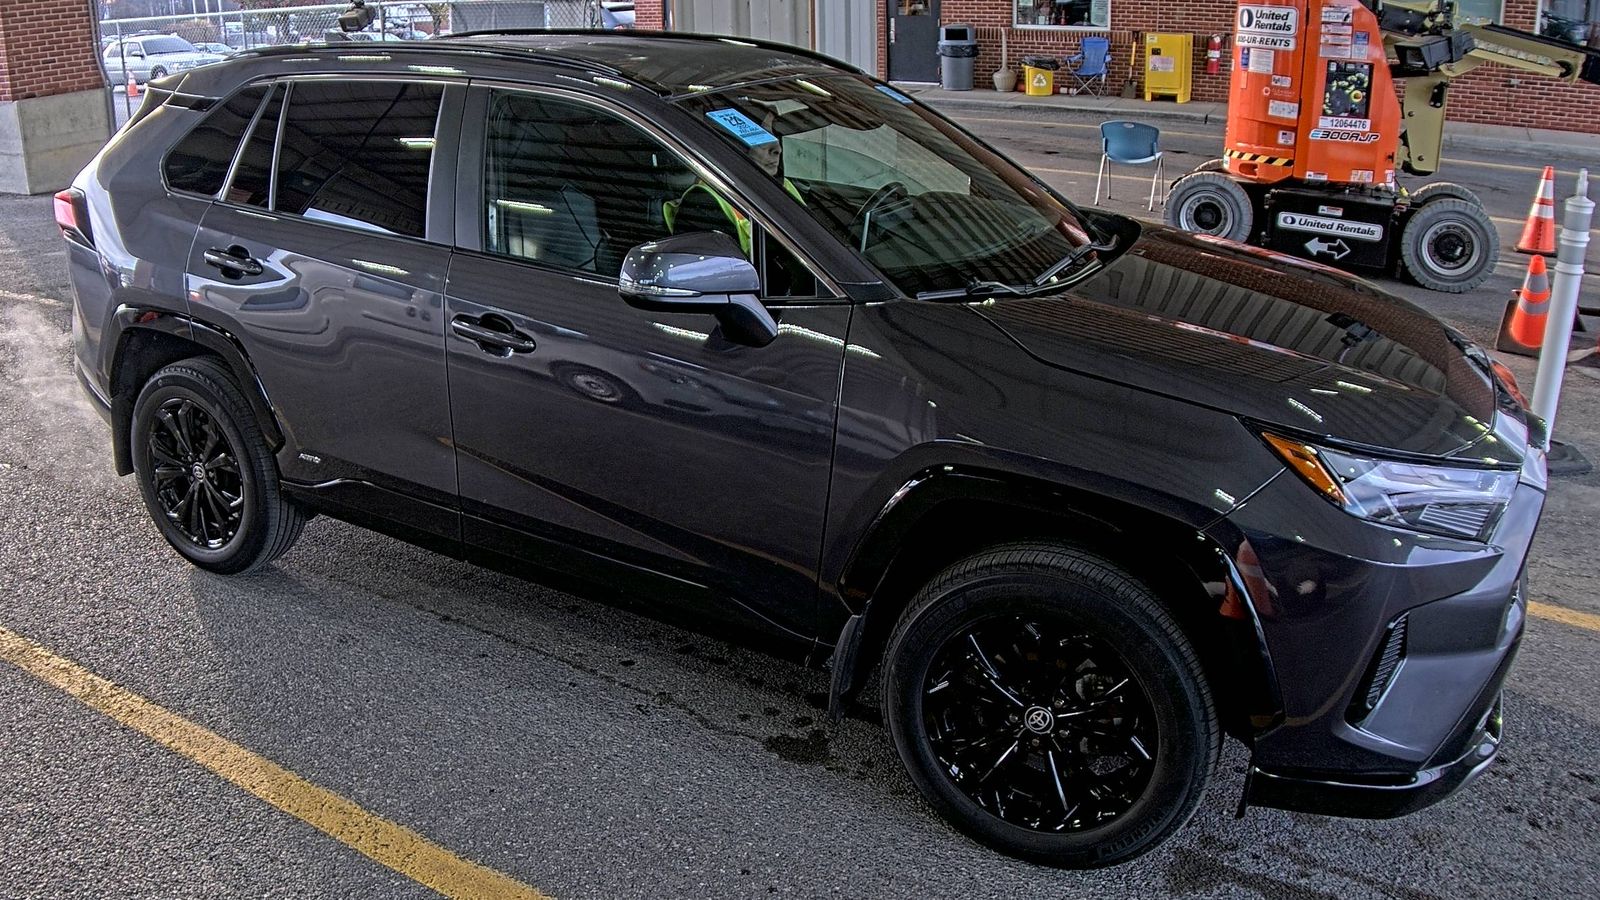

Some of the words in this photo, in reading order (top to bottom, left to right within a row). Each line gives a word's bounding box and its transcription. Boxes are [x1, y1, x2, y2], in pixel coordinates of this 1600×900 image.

[1255, 10, 1290, 20] United
[1254, 20, 1292, 31] Rentals
[1330, 119, 1367, 129] 12064476
[1311, 130, 1379, 142] E300AJP
[1299, 218, 1334, 229] United
[1336, 224, 1376, 236] Rentals
